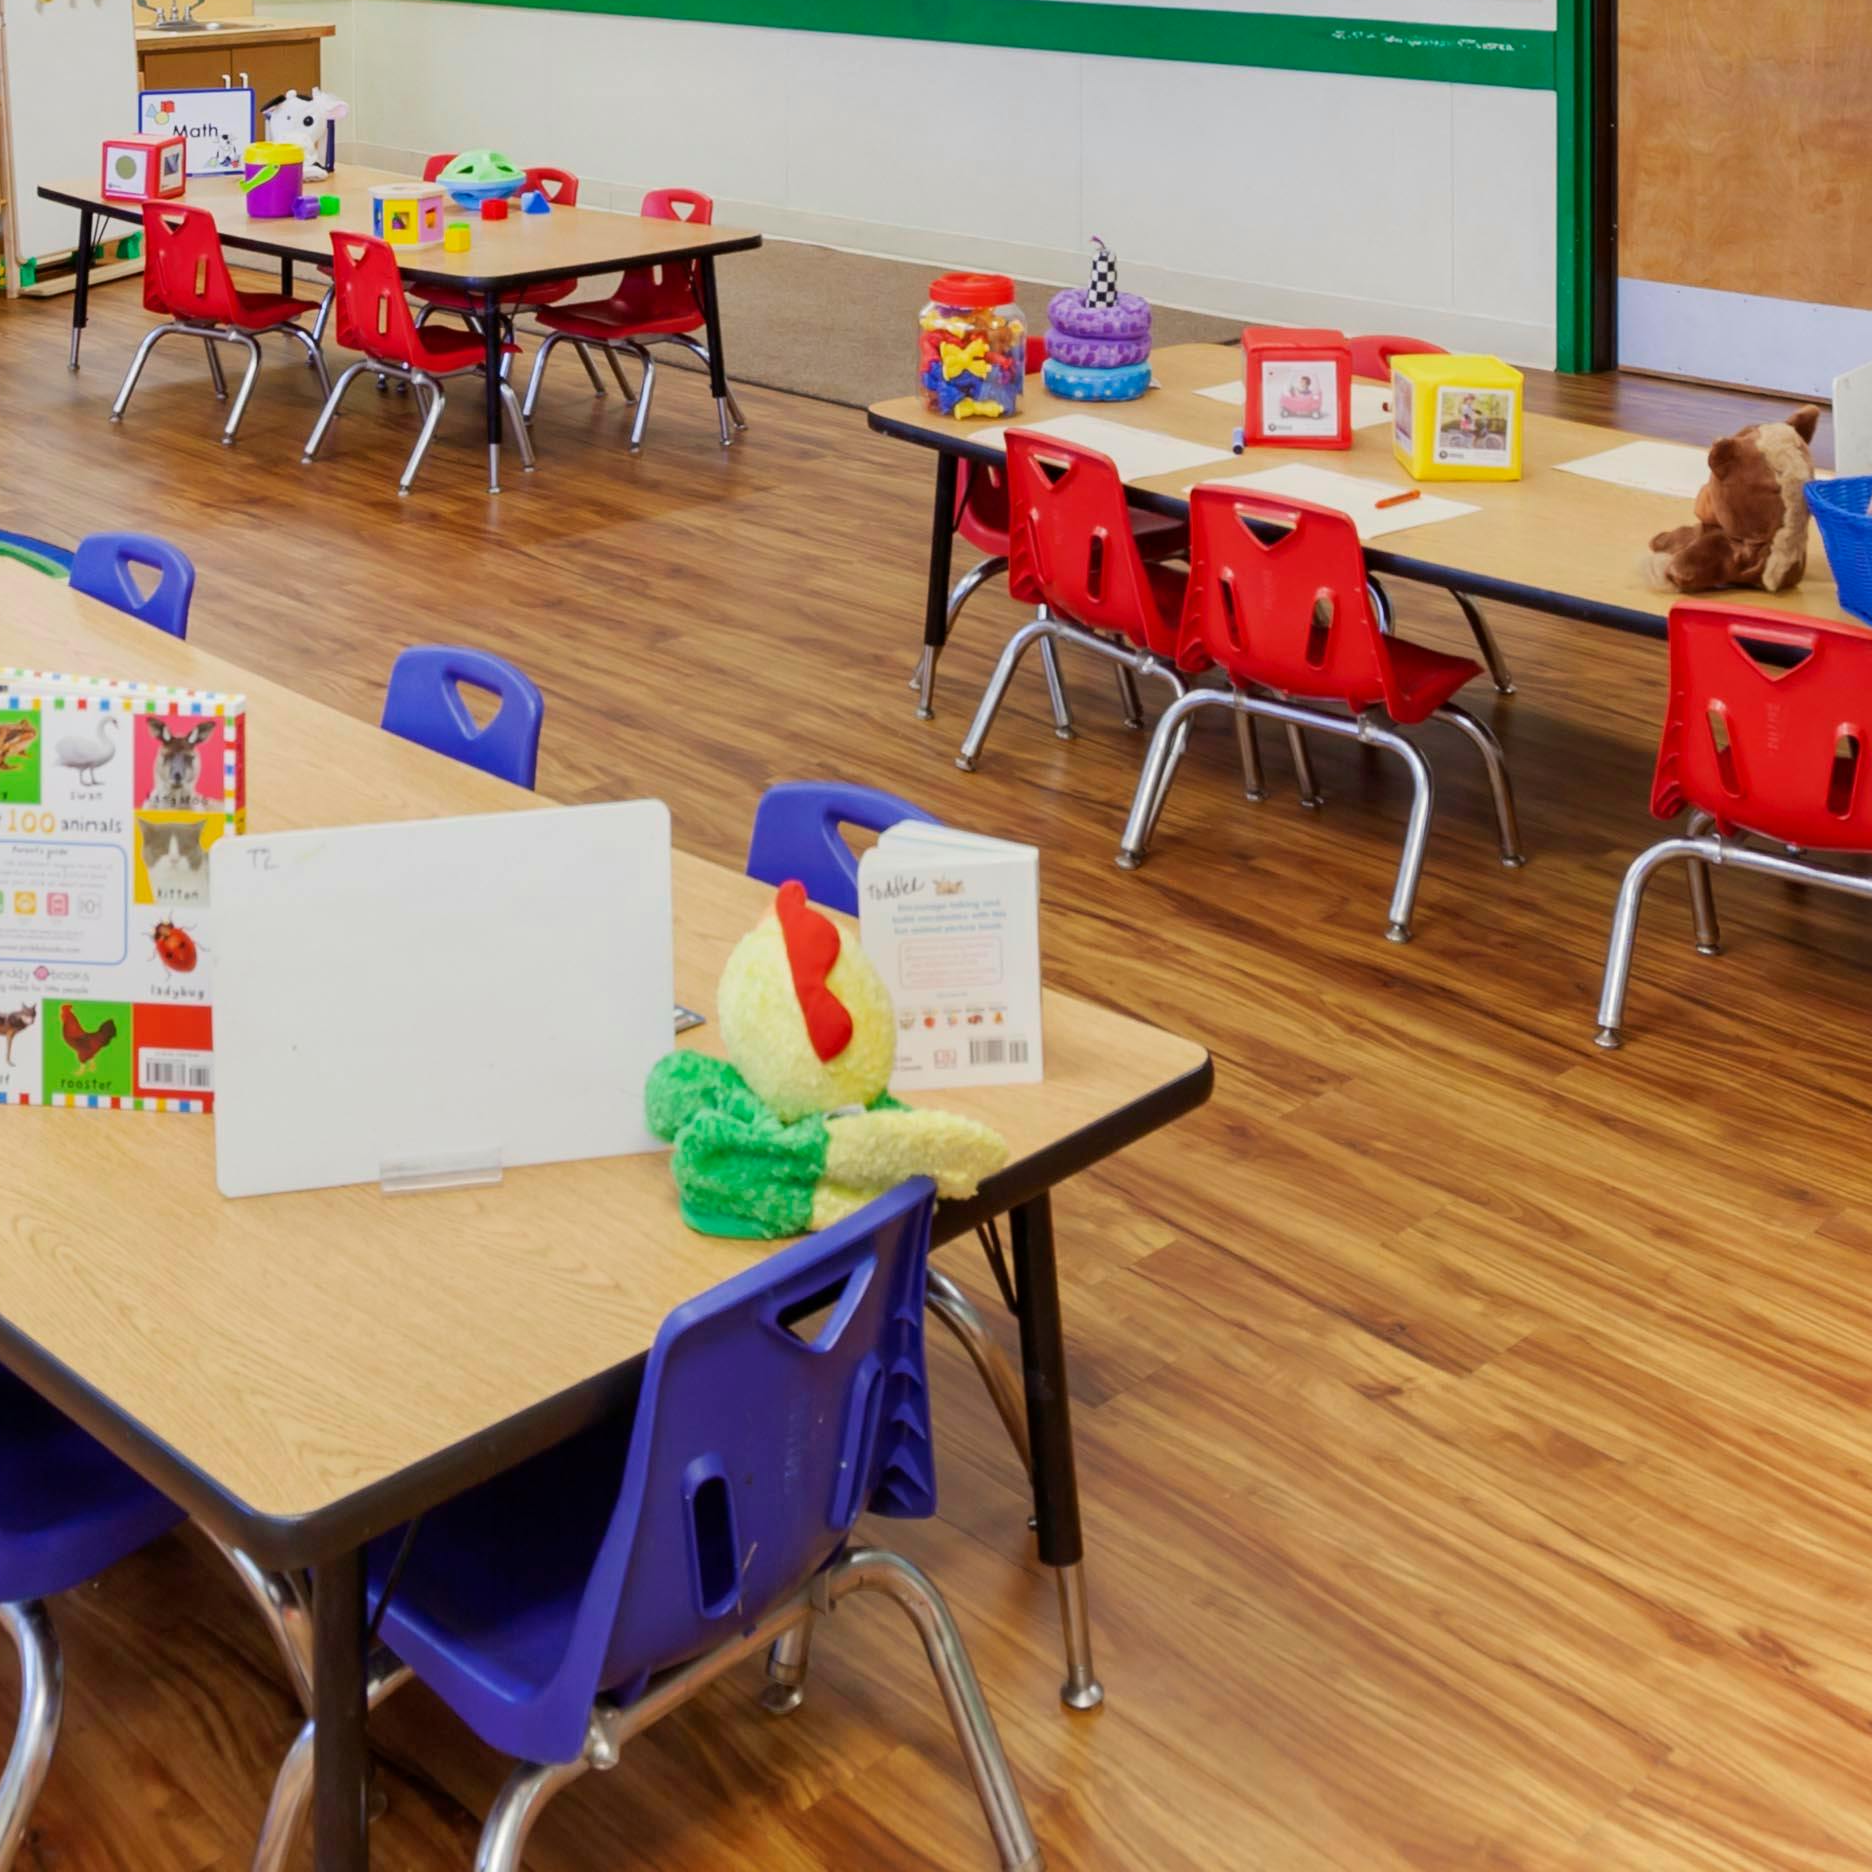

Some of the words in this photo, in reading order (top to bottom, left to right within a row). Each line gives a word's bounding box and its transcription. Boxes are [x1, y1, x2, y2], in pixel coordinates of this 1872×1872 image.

[173, 122, 219, 138] Math
[7, 808, 56, 834] 100
[60, 818, 122, 834] animals
[157, 888, 200, 900] kitten
[150, 984, 205, 1000] ladybug
[60, 1078, 113, 1091] rooster
